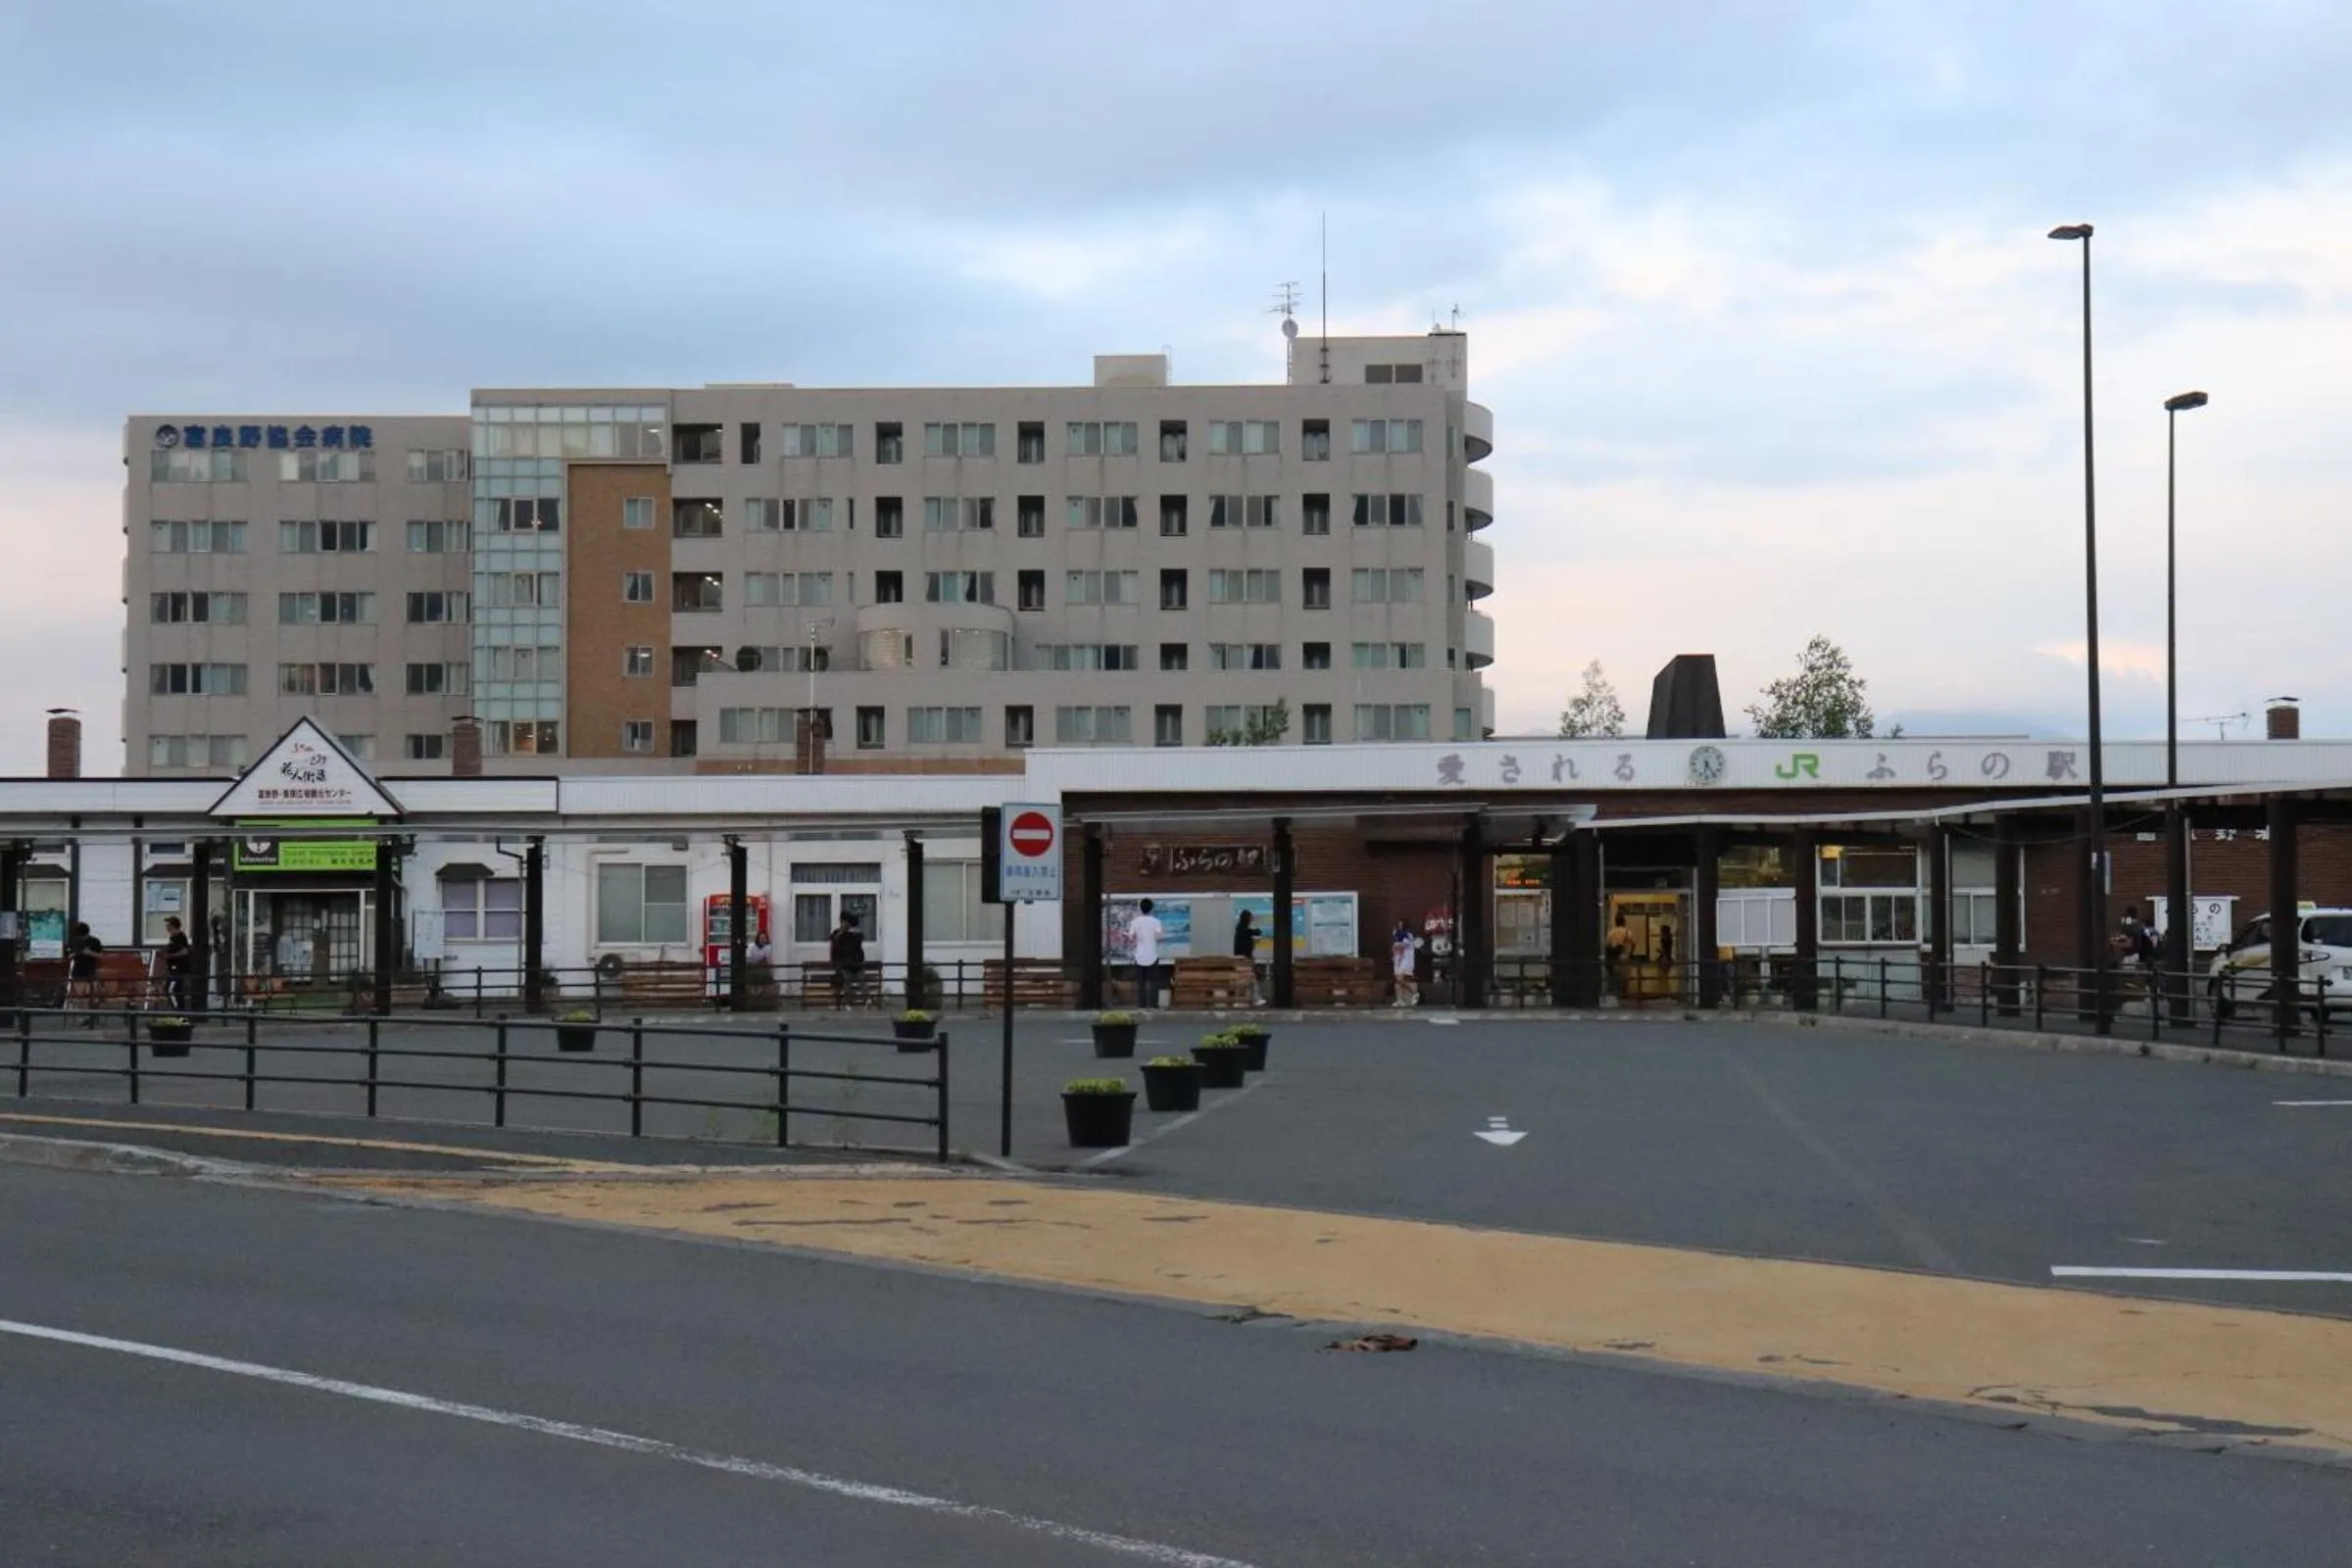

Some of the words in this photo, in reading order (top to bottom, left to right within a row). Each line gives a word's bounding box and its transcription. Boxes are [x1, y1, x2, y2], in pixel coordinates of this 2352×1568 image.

[183, 423, 373, 449] 富良野協会病院
[1437, 753, 1636, 784] 愛される
[1776, 753, 1820, 779] JR
[1865, 751, 2079, 780] ふらの駅
